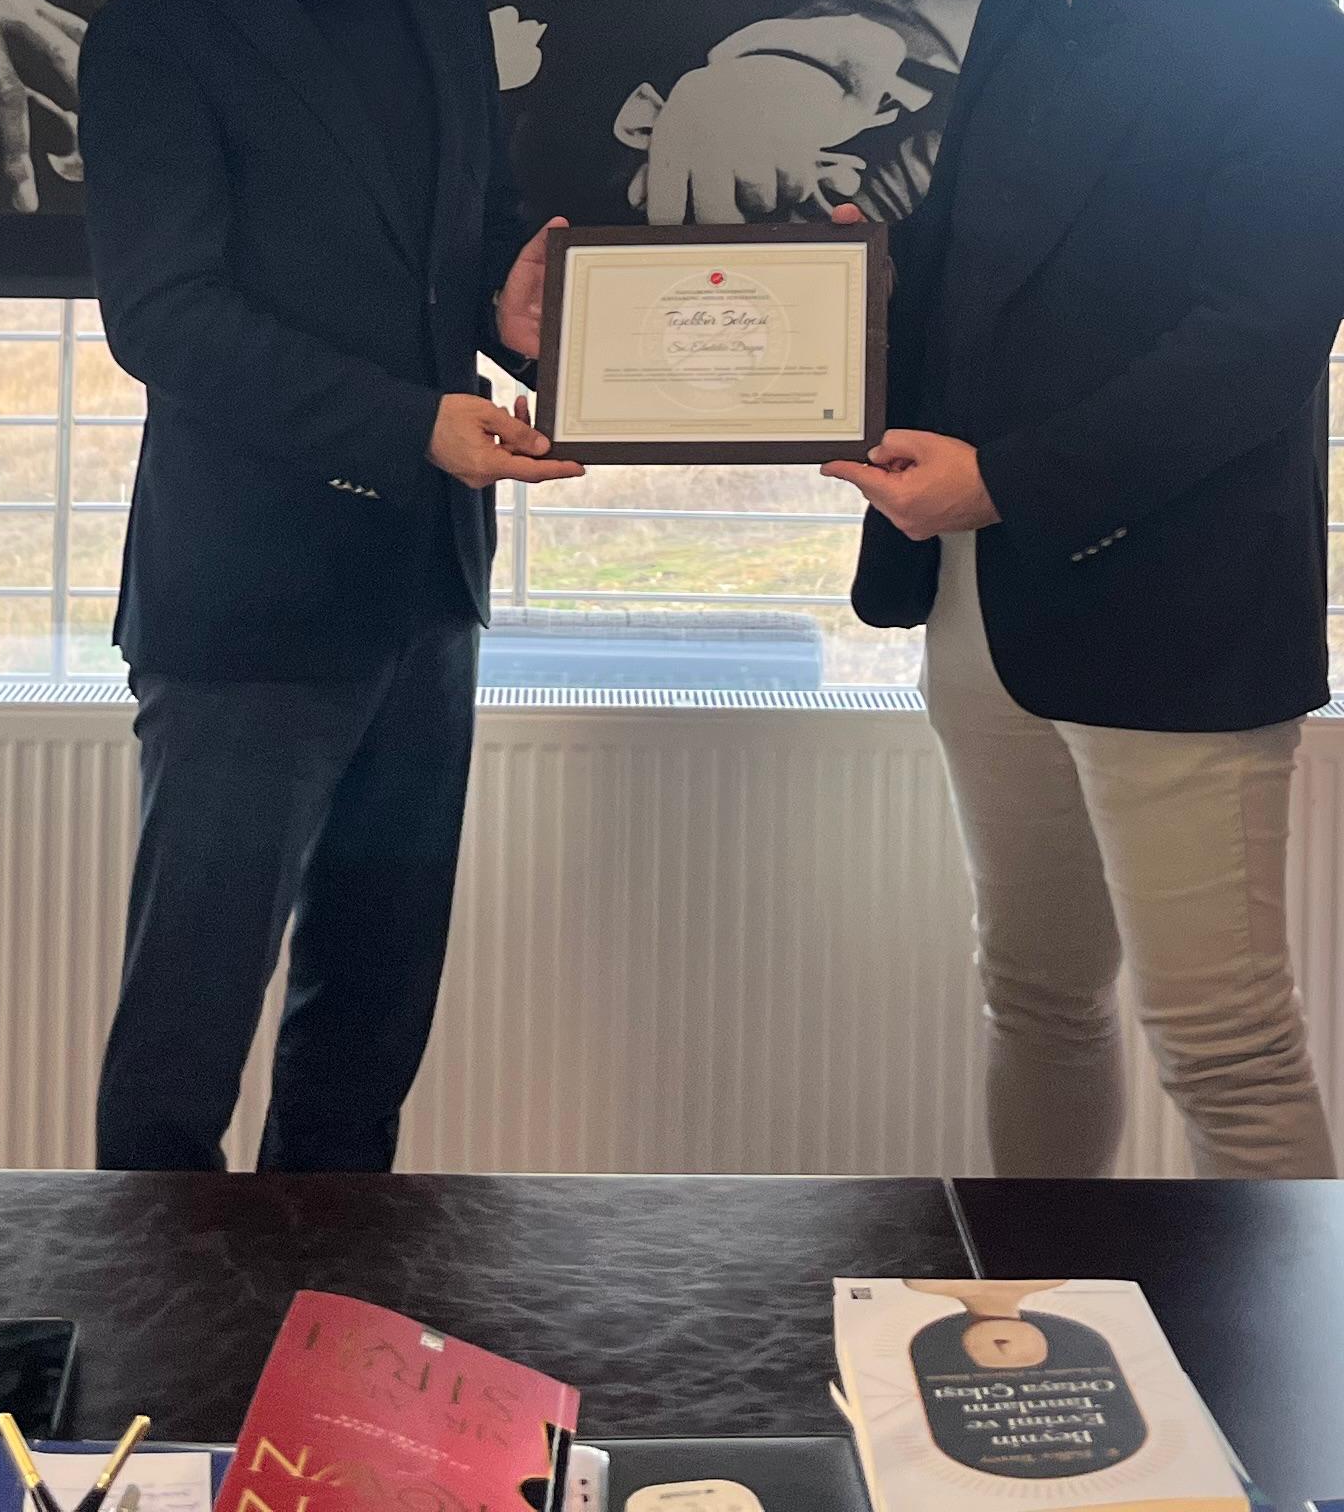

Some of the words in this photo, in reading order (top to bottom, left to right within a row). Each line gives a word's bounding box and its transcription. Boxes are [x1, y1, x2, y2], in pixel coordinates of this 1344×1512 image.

[935, 1383, 1014, 1401] Çıkışı
[1020, 1379, 1116, 1393] Ortaya
[961, 1397, 1101, 1413] Tanrıların
[964, 1419, 1000, 1430] ve
[1007, 1412, 1105, 1429] Evrimi
[991, 1430, 1093, 1447] Beynin
